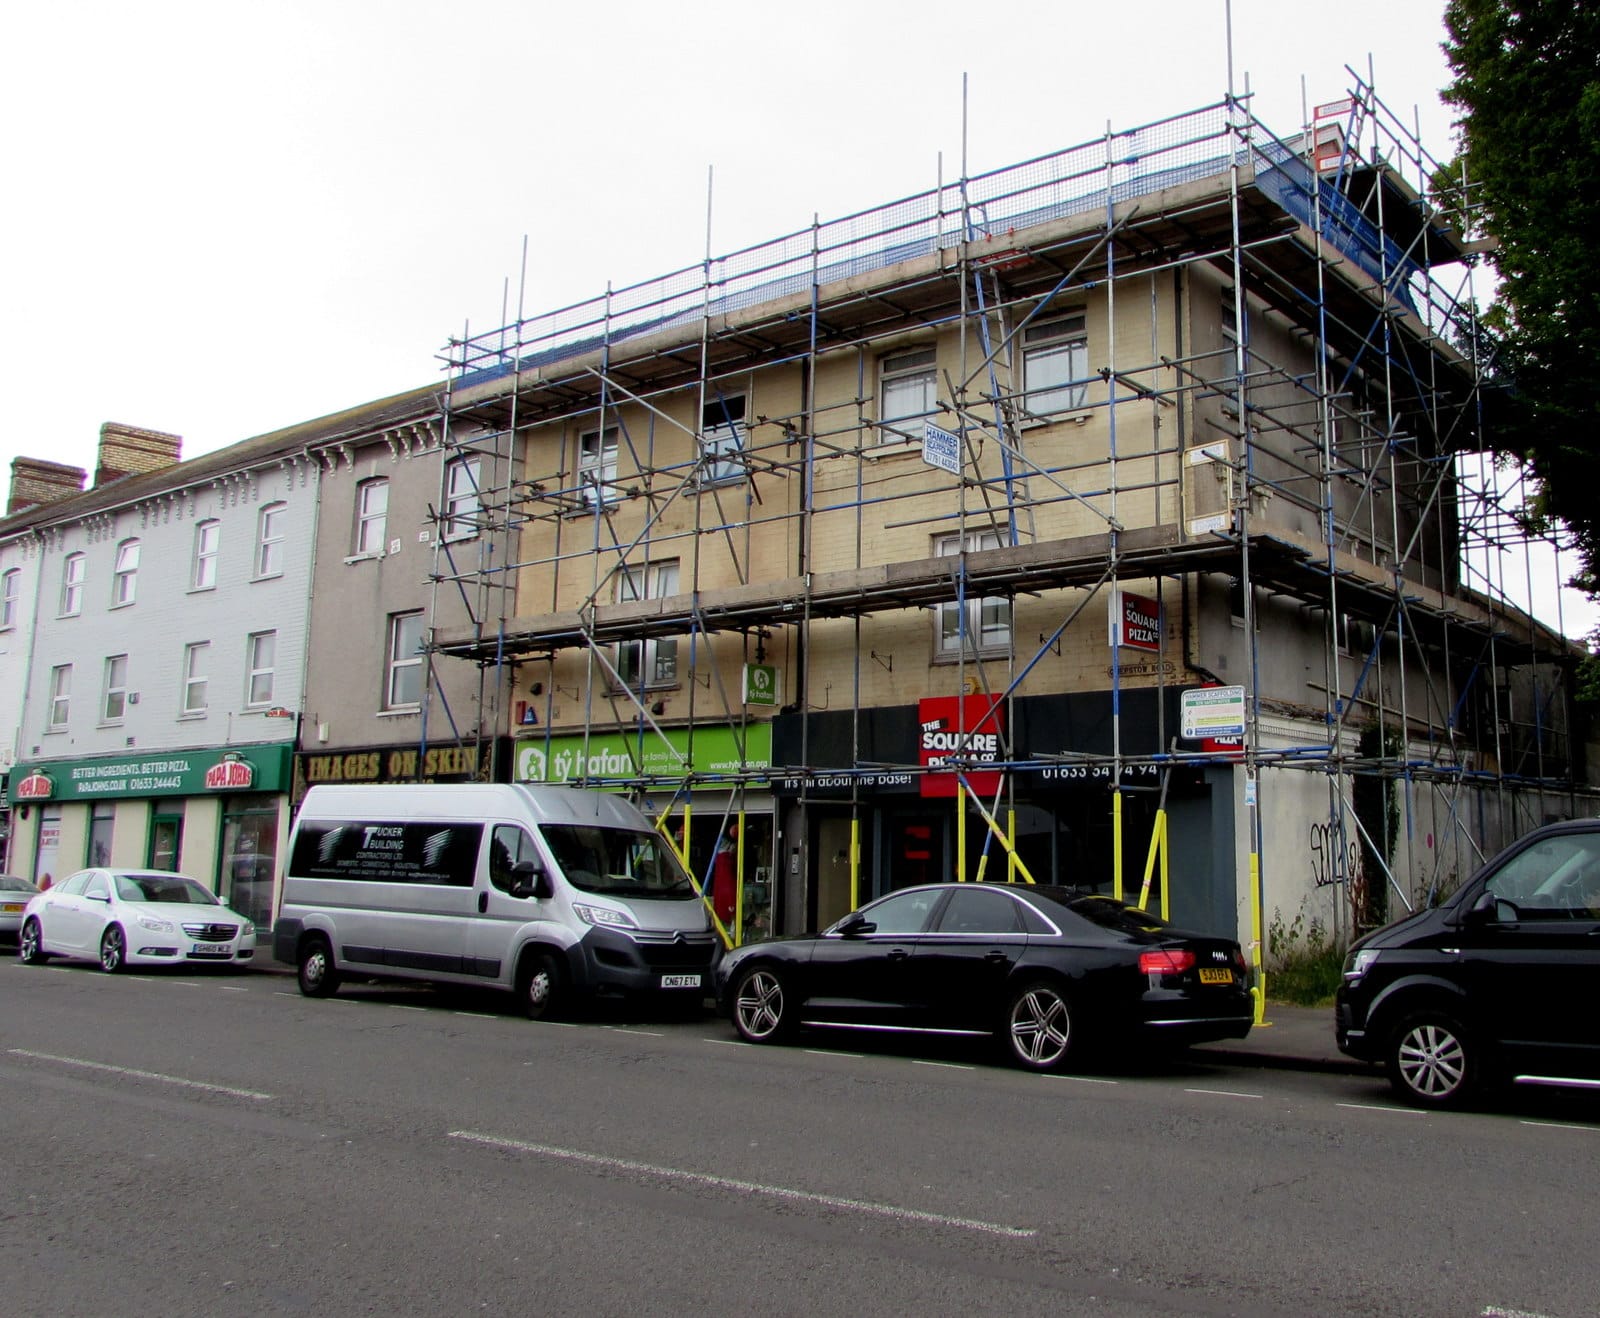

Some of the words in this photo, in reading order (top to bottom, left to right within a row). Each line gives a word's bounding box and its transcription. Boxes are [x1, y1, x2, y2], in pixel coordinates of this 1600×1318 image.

[927, 428, 958, 448] HAMMER
[926, 440, 958, 458] SCAFFOLDING
[1126, 609, 1159, 631] SQUARE
[1128, 628, 1153, 643] PIZZA
[1108, 664, 1147, 676] CEPSTOW
[921, 719, 941, 732] THE
[922, 732, 997, 752] SQUARE
[72, 767, 96, 779] BETTER
[96, 764, 141, 777] INGREDIENTS.
[141, 761, 168, 774] BETTER
[308, 752, 380, 781] IMAGES
[389, 750, 418, 777] ON
[425, 746, 478, 776] SKIN
[576, 748, 633, 776] hafan
[710, 760, 768, 771] www.tyhaan.org
[130, 778, 153, 790] 01633
[207, 765, 226, 787] PAPA
[818, 776, 852, 787] about
[878, 774, 912, 785] base!
[362, 826, 403, 849] TUCKER
[370, 840, 404, 850] BUILDING
[665, 976, 684, 986] CN67
[684, 976, 698, 986] ETL
